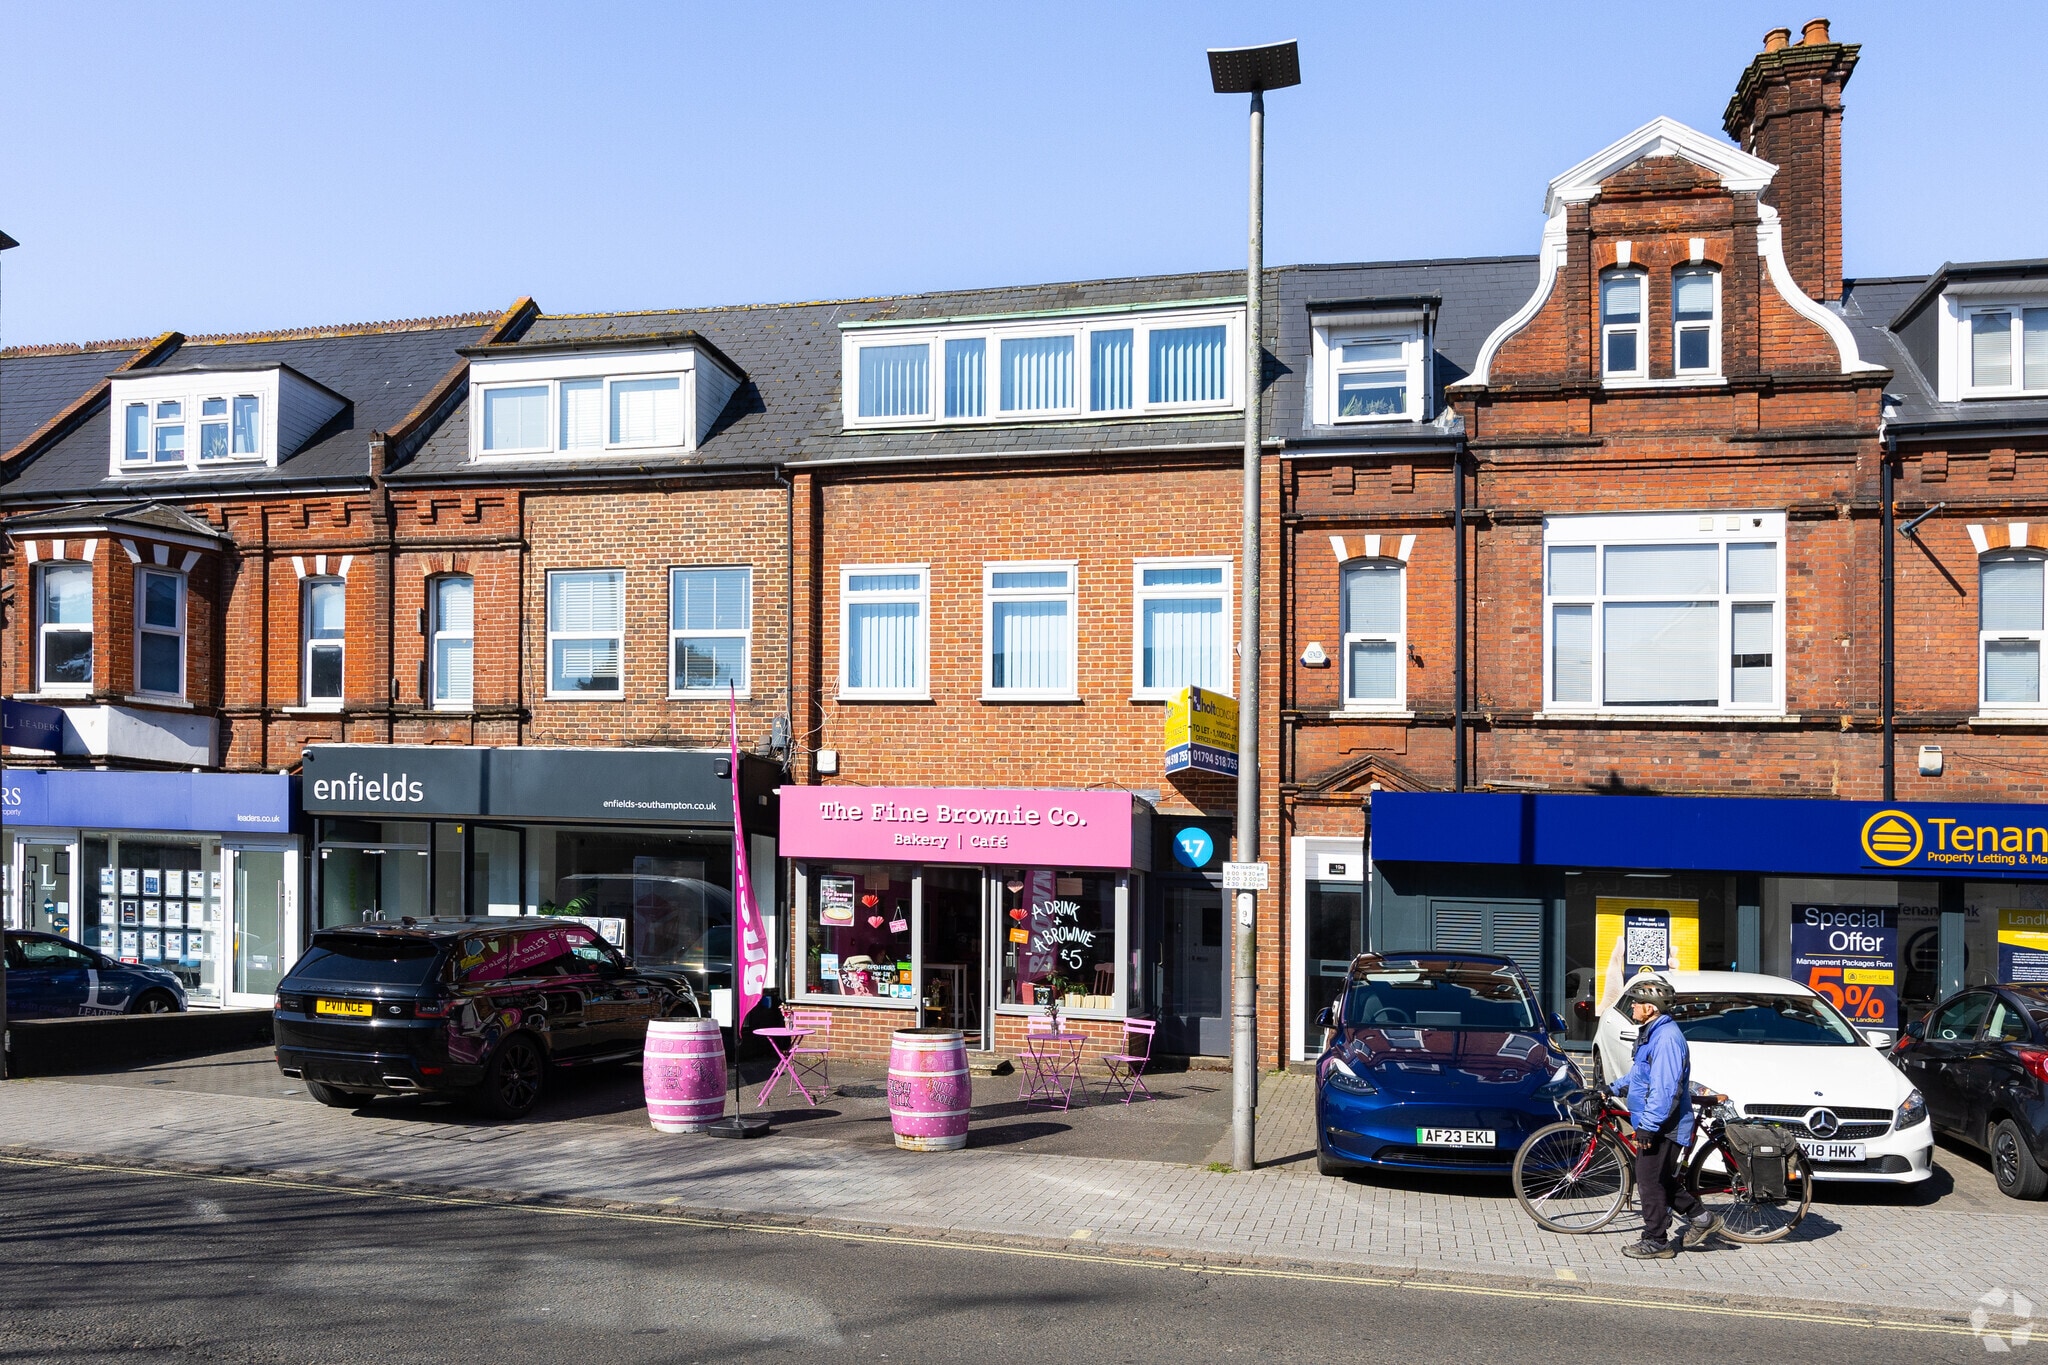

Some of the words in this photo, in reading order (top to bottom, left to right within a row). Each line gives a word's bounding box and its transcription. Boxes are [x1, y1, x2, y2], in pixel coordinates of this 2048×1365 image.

[4, 714, 14, 729] L
[20, 719, 60, 732] LEADERS
[1193, 724, 1200, 732] TO
[1201, 725, 1210, 735] LET
[1179, 750, 1188, 763] 755
[1193, 750, 1213, 764] 01794
[1215, 754, 1226, 767] 518
[1227, 757, 1238, 770] 755
[313, 773, 424, 803] enfields
[603, 799, 718, 812] enfields-southampton.co.uk
[237, 814, 281, 823] leaders.co.uk
[819, 801, 863, 821] The
[870, 803, 929, 823] Fine
[936, 804, 1041, 826] Brownie
[1047, 806, 1088, 827] Co.
[894, 833, 949, 849] Bakery
[970, 834, 1009, 849] Café
[1181, 839, 1205, 858] 17
[1927, 852, 1975, 865] Property
[1977, 853, 2016, 866] Letting
[2019, 854, 2029, 864] &
[41, 864, 57, 887] L
[1031, 903, 1046, 920] A
[1045, 900, 1080, 922] DRINK
[1897, 903, 1938, 917] Tenan
[1804, 907, 1884, 930] Special
[1034, 937, 1050, 952] A
[1042, 926, 1096, 948] BROWNIE
[1829, 931, 1885, 952] Offer
[1060, 949, 1083, 970] £5
[1796, 958, 1841, 968] Management
[1842, 959, 1875, 968] Packages
[1876, 960, 1893, 968] From
[1808, 967, 1885, 1019] 5%
[324, 1000, 342, 1011] PV11
[345, 1001, 364, 1012] NCE
[1426, 1130, 1462, 1143] AF23
[1466, 1131, 1494, 1144] EKL
[1801, 1144, 1825, 1158] X18
[1829, 1145, 1857, 1158] HMK
